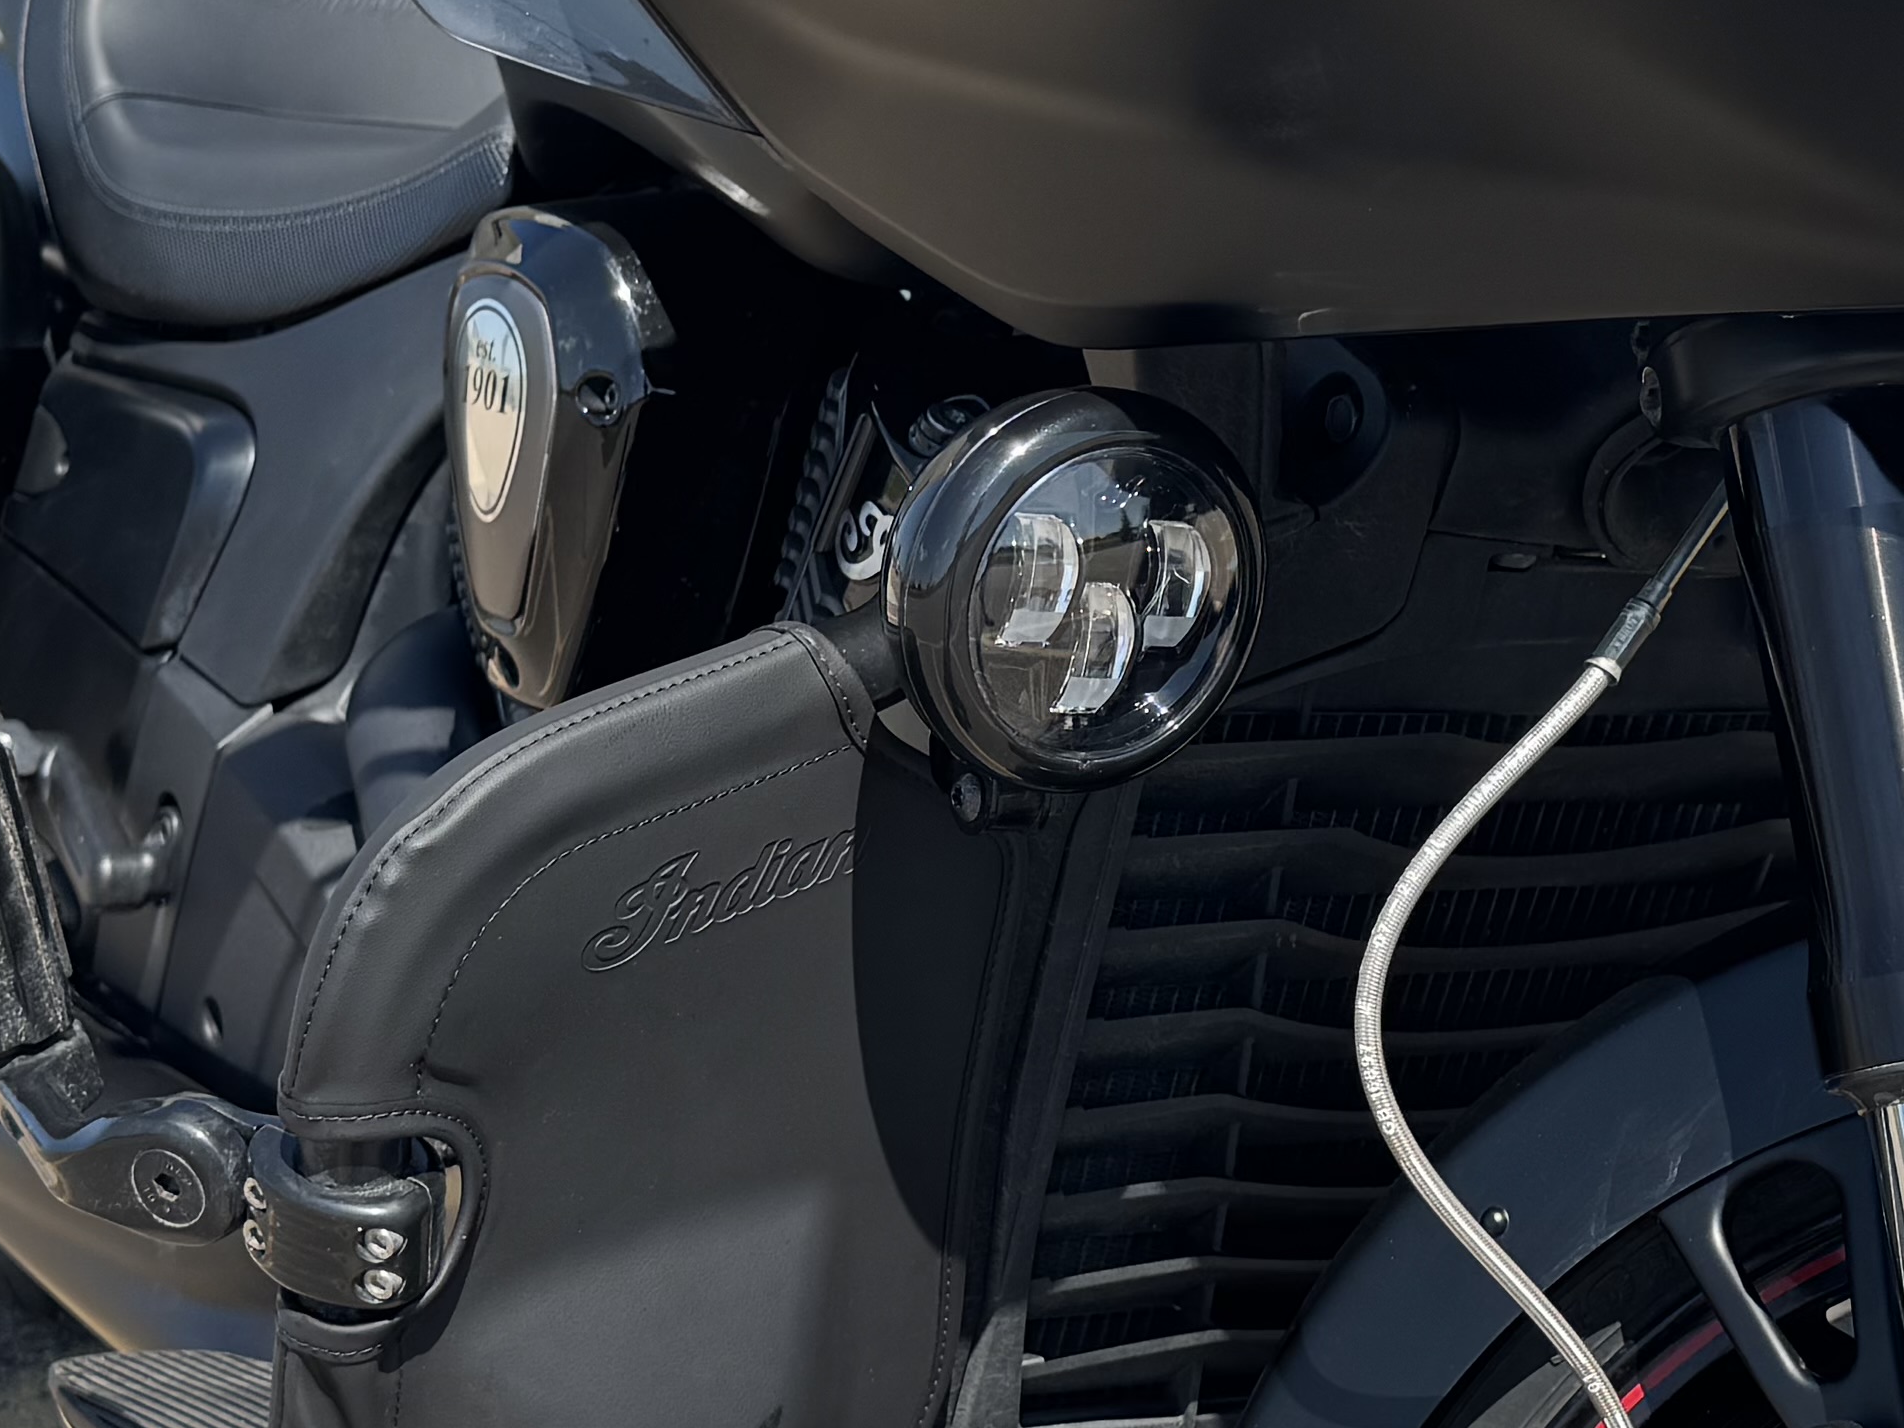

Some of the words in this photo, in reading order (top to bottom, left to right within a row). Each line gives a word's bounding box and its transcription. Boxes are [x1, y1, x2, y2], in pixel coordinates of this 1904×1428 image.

[476, 339, 496, 362] est.
[463, 363, 510, 414] 1901
[580, 826, 866, 973] Indian
